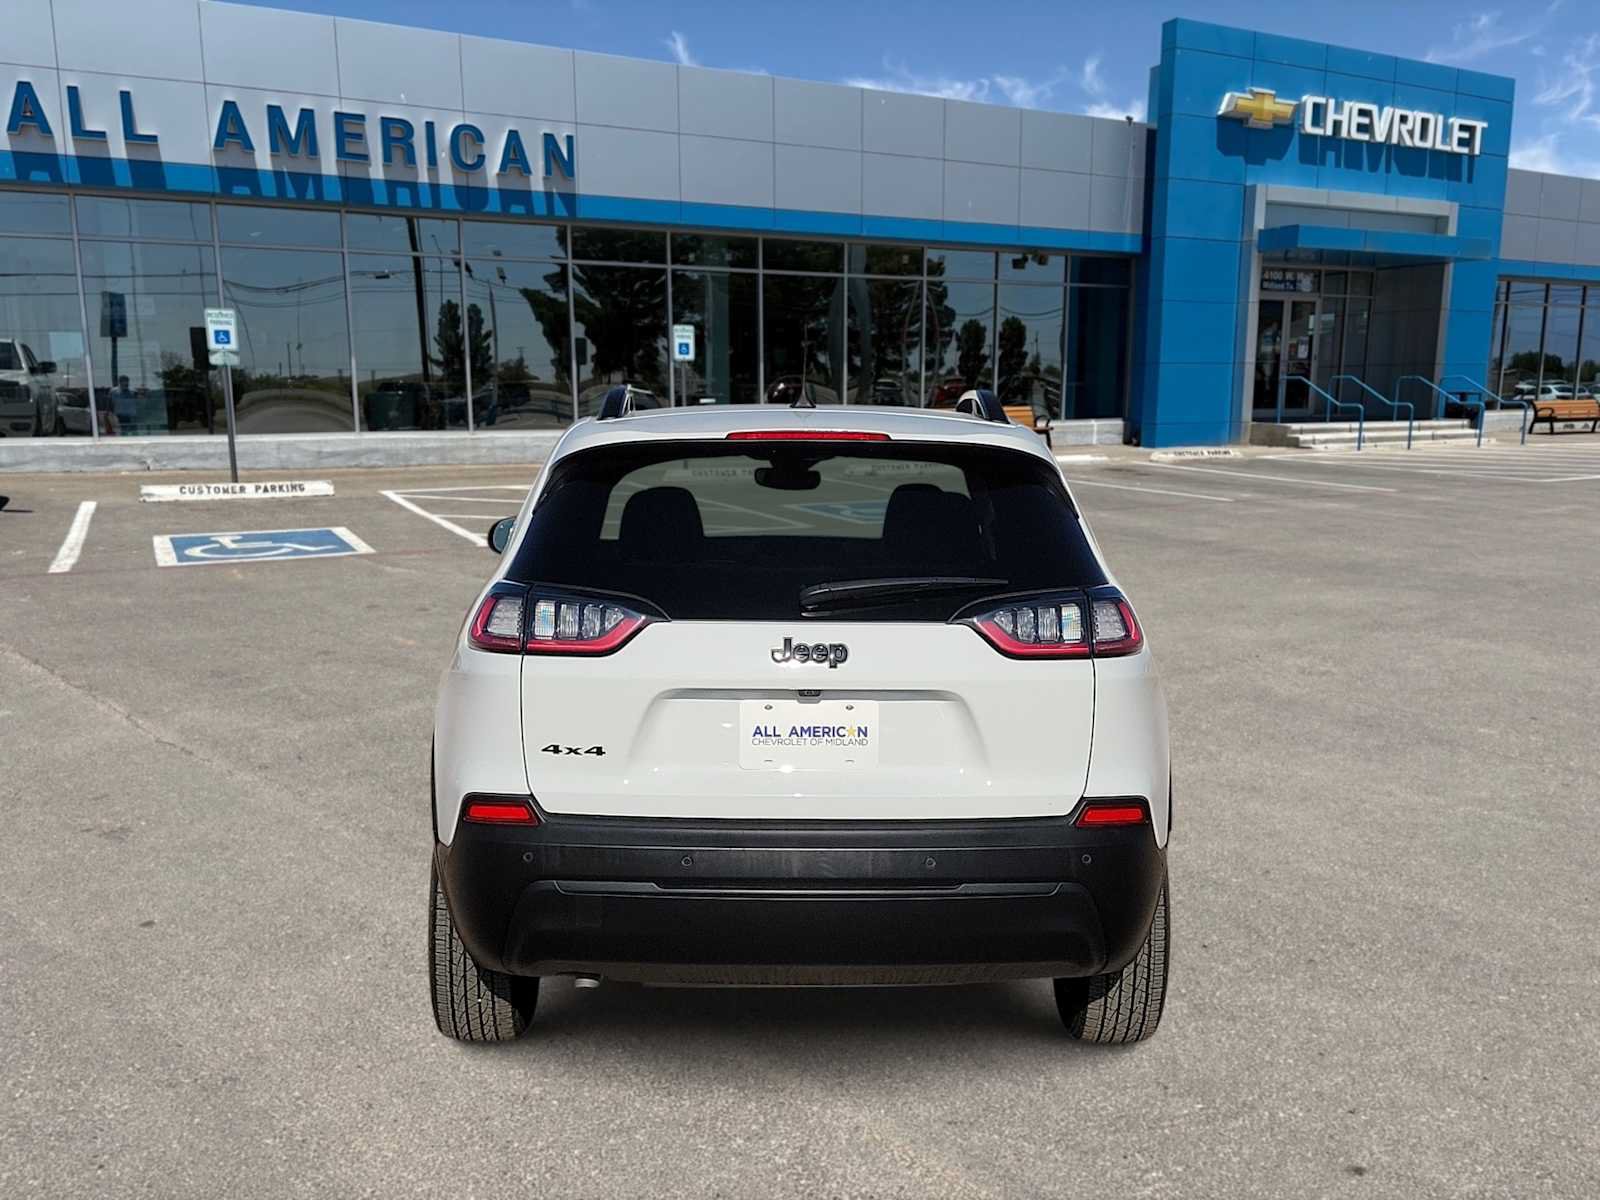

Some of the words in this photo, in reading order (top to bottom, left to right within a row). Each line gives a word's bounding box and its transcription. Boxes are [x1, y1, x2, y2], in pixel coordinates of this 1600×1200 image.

[7, 80, 159, 144] ALL
[212, 100, 576, 180] AMERICAN
[1301, 94, 1488, 156] CHEVROLET
[179, 485, 246, 495] CUSTOMER
[255, 483, 305, 493] PARKING
[771, 637, 848, 668] Jeep
[752, 725, 781, 738] ALL
[788, 725, 868, 738] AMERICN
[752, 738, 807, 746] CHEVROLET
[809, 738, 823, 746] OF
[825, 738, 869, 746] MIDLAND
[541, 744, 606, 756] 4x4
